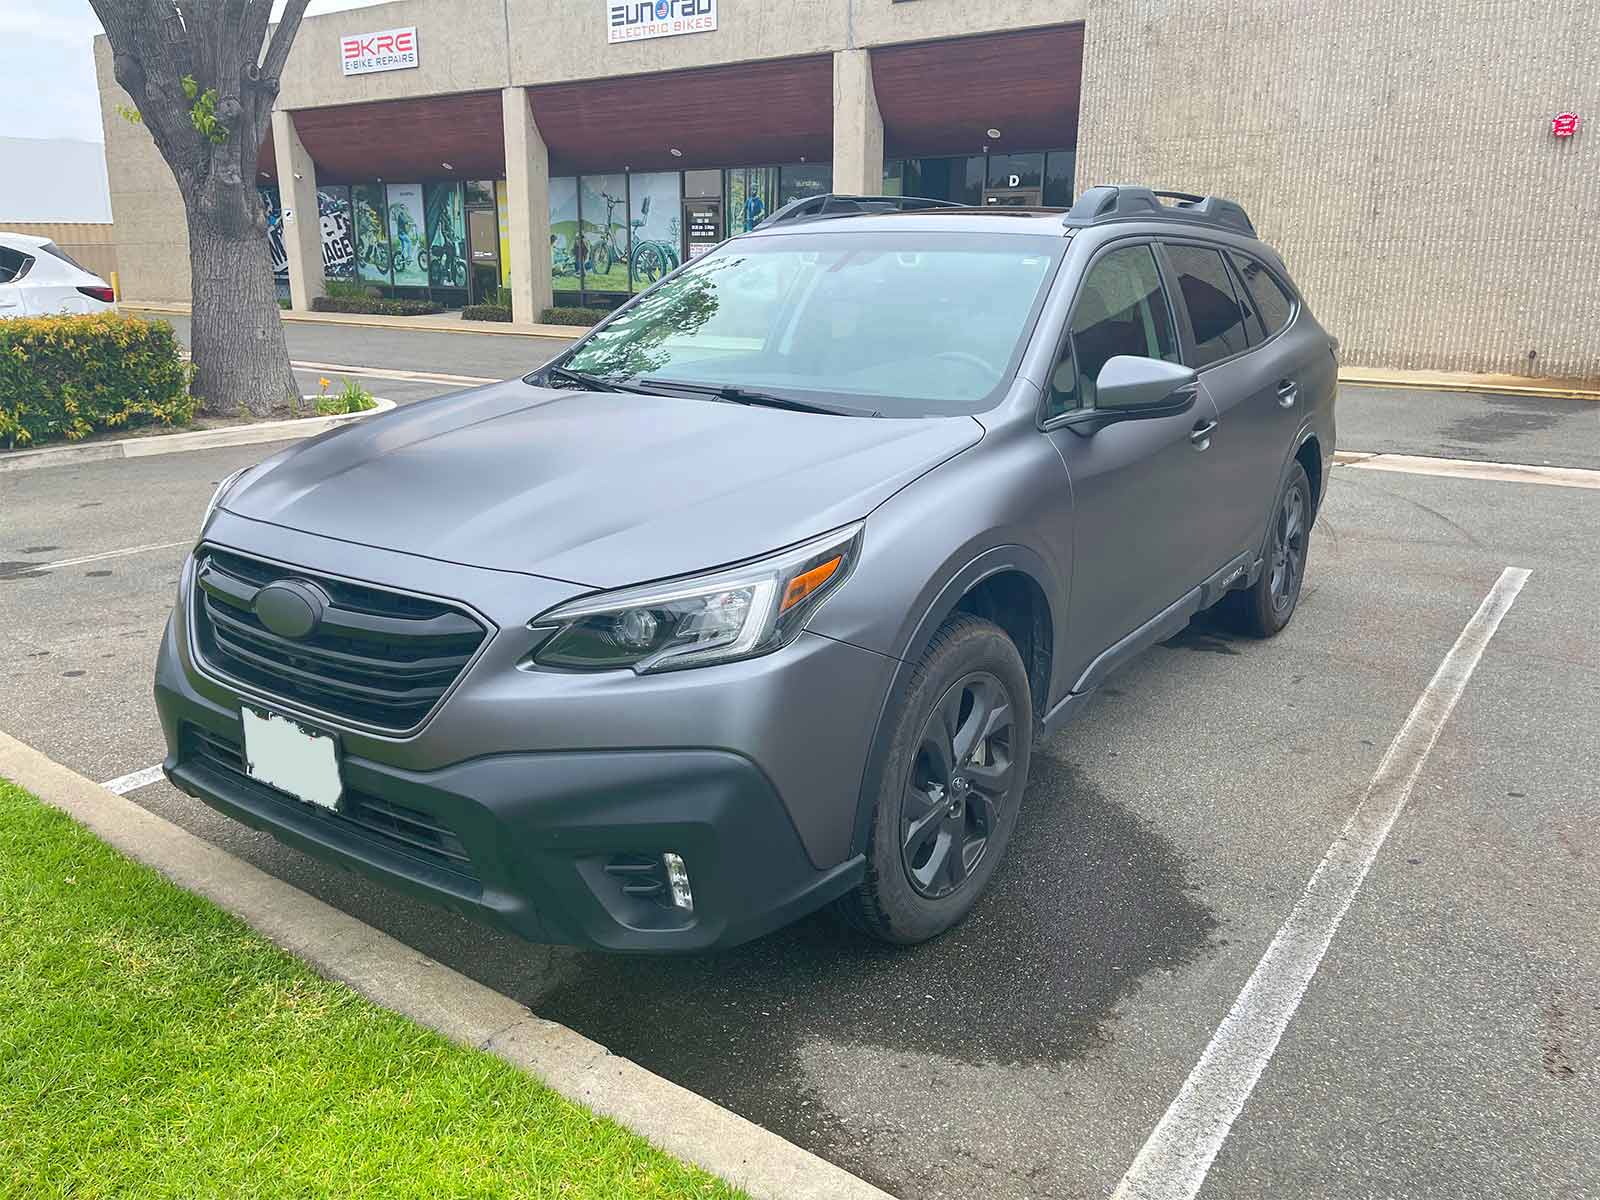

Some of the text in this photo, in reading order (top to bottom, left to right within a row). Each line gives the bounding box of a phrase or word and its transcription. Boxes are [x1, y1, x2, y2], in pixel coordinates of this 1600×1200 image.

[611, 16, 713, 40] ELECTRIC BIKES
[376, 53, 415, 66] REPAIRS
[1009, 174, 1020, 187] D
[321, 236, 354, 265] AGE
